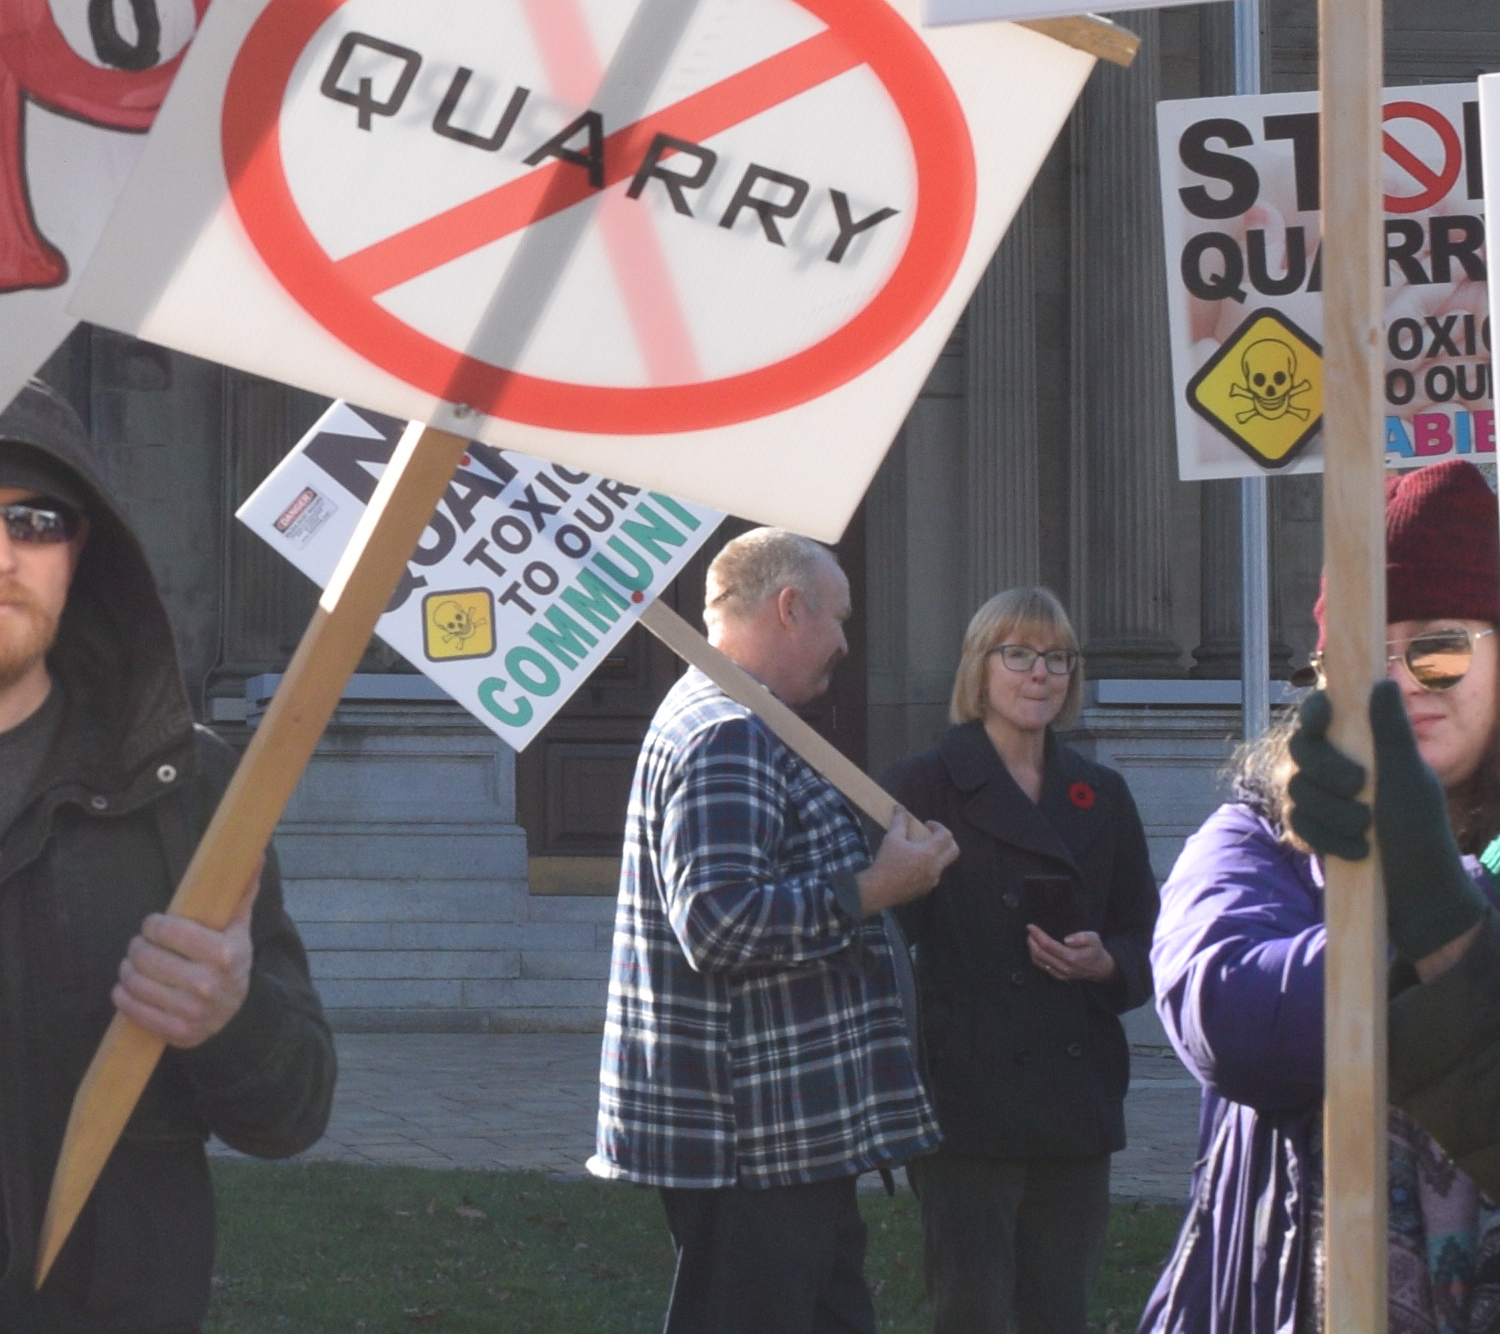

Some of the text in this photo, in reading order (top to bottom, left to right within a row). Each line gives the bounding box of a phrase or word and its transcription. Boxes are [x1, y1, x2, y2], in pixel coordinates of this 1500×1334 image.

[320, 29, 901, 265] QUARRY
[1180, 214, 1490, 305] QURR
[1387, 314, 1493, 361] OXI
[1424, 364, 1495, 403] OU
[498, 478, 641, 616] TO OUR
